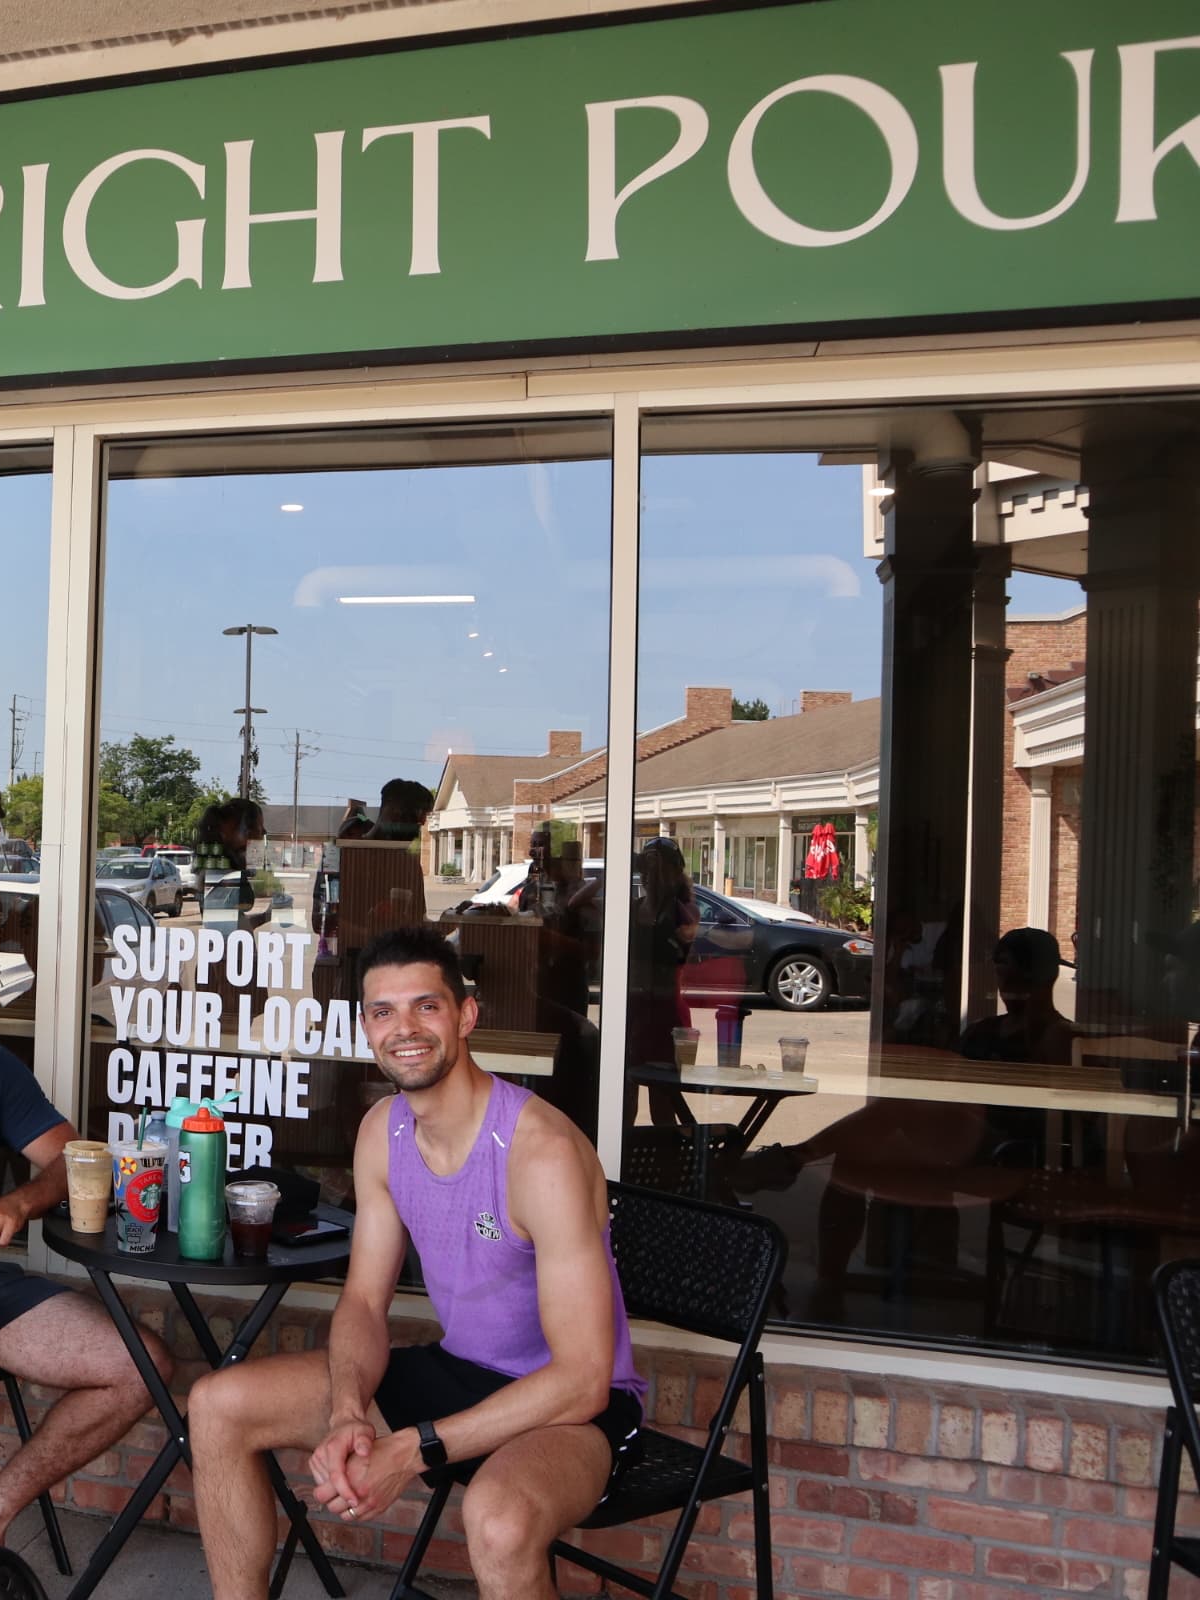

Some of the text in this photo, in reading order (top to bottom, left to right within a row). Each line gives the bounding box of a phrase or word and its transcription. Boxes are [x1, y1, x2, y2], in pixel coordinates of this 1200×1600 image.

[111, 924, 312, 990] SUPPORT
[110, 986, 375, 1059] YOUR LOCAL
[107, 1047, 310, 1120] CAFFEINE
